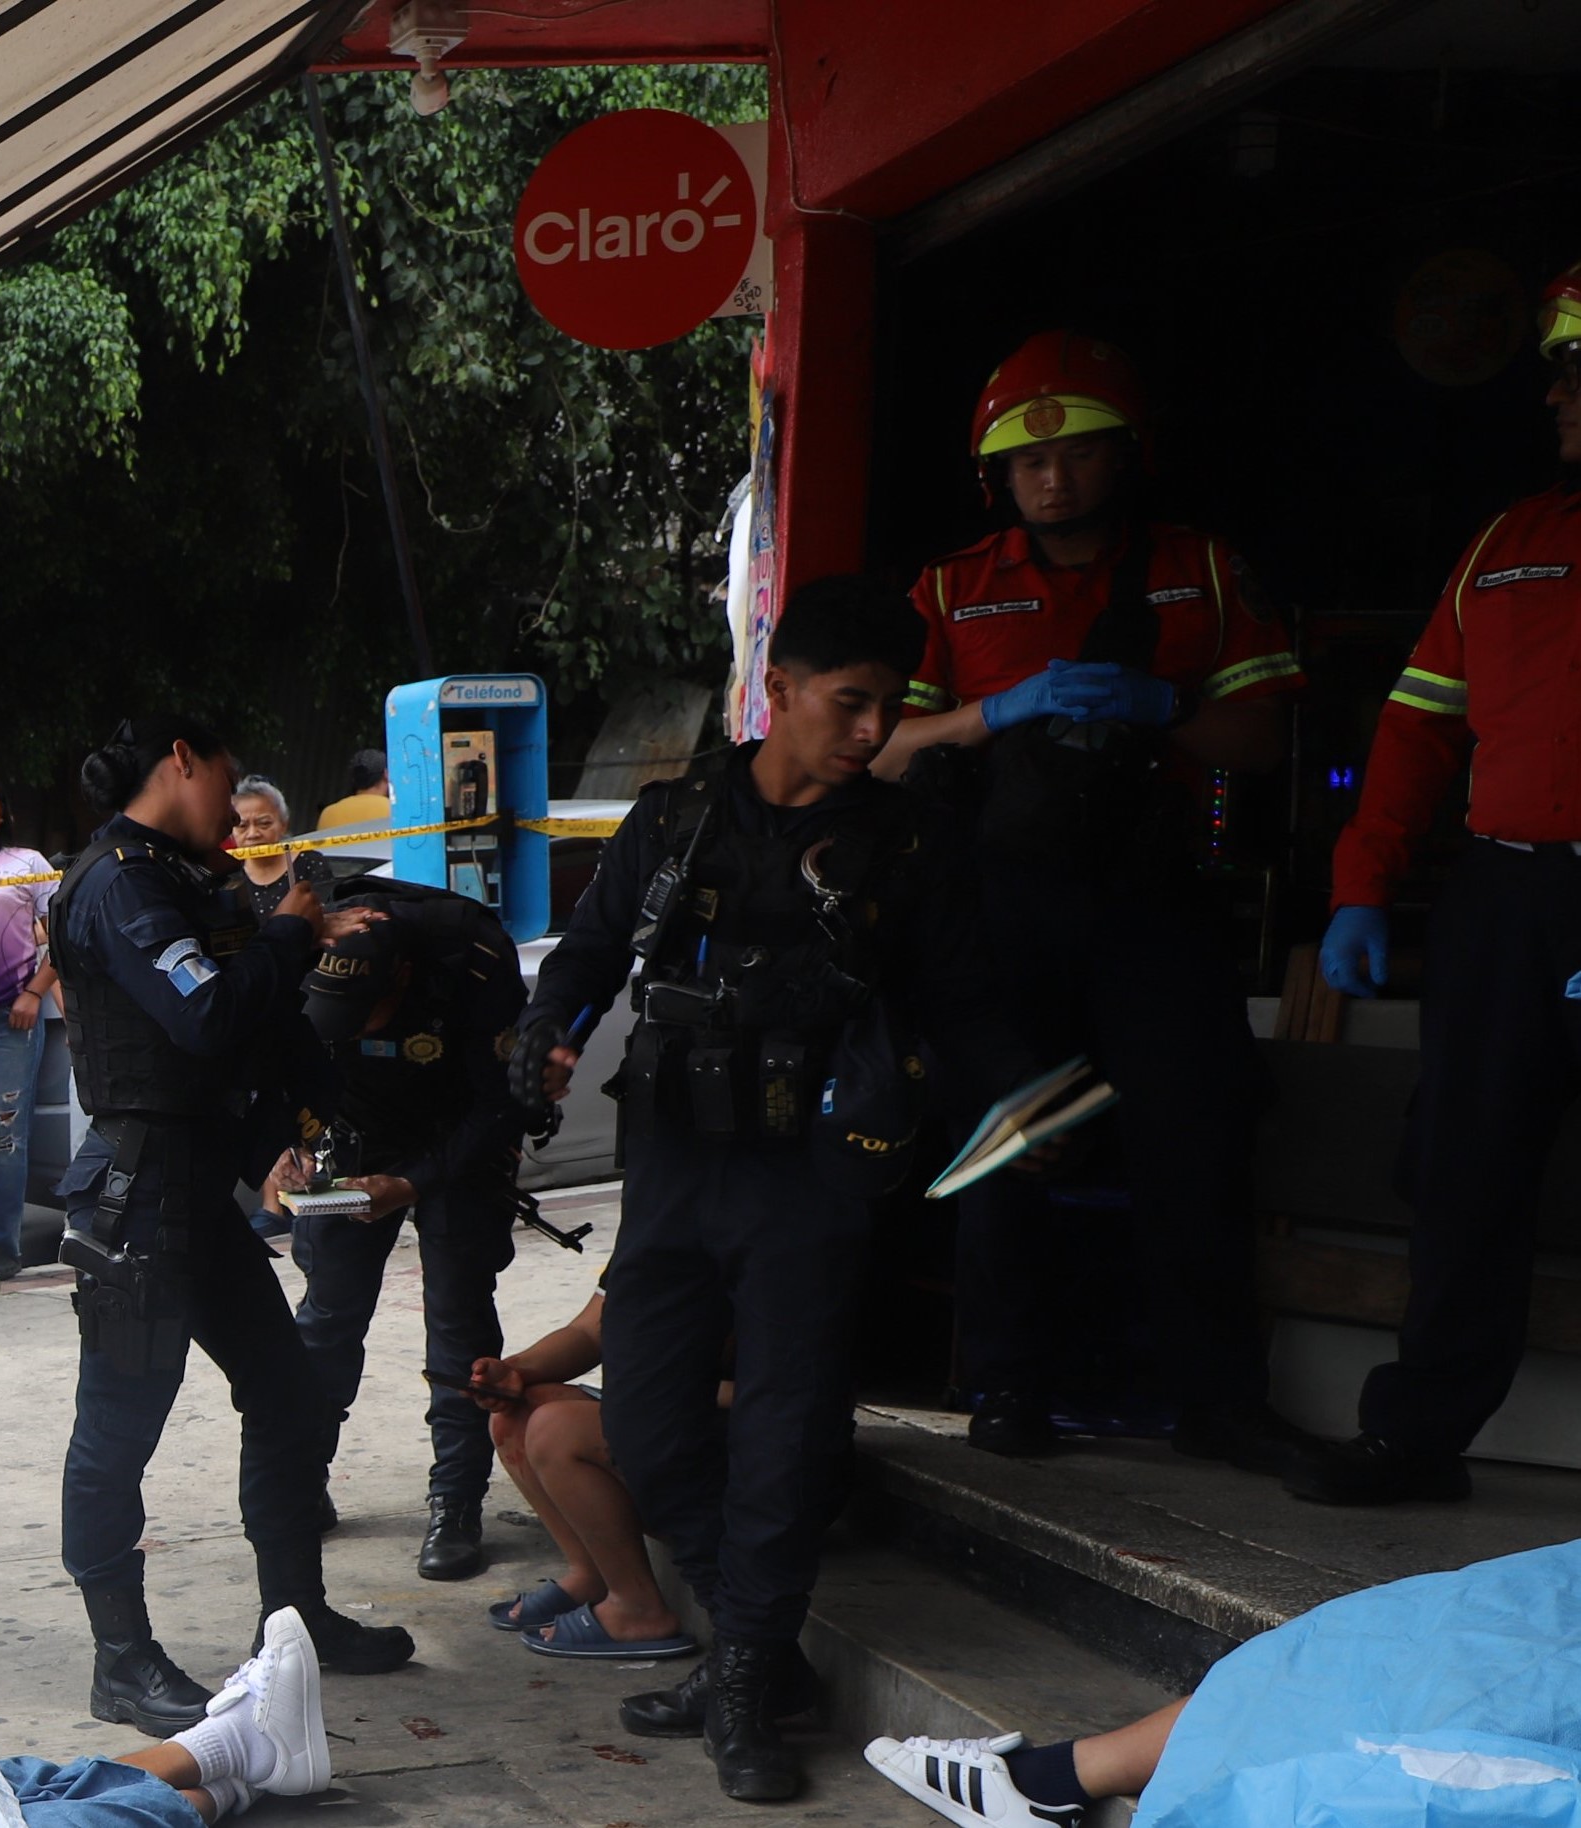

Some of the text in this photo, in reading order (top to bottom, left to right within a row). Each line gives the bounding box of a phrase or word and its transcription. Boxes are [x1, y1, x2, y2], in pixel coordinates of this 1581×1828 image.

[524, 208, 704, 265] Claro
[8, 871, 61, 886] ESCENA
[319, 952, 370, 976] LICIA
